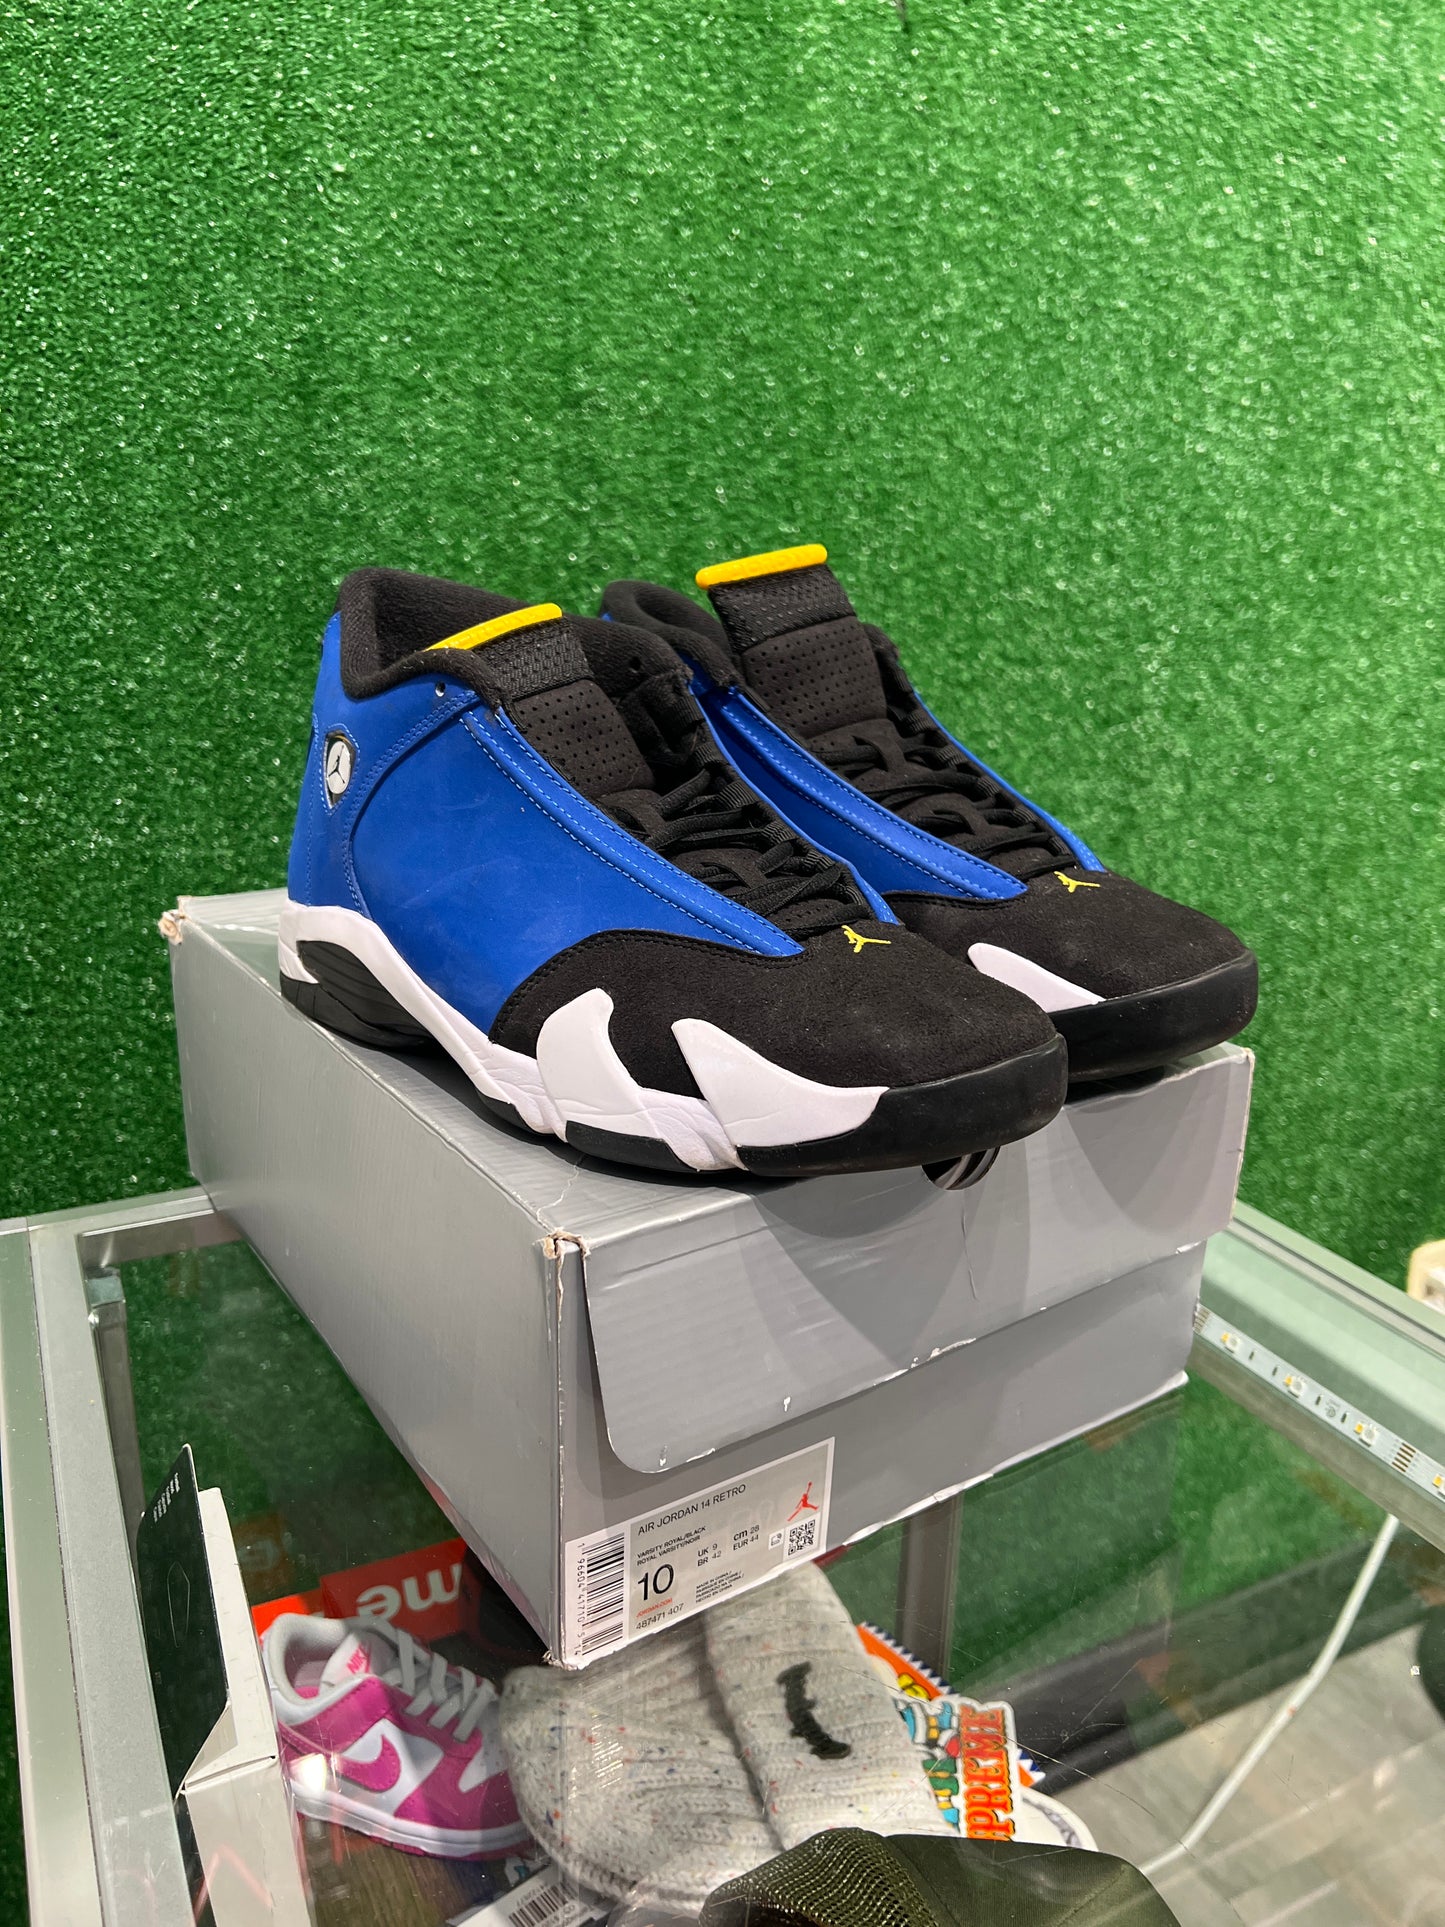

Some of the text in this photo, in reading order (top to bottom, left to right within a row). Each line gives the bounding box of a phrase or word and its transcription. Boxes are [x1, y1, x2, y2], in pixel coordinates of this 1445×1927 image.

[638, 1484, 746, 1536] AIR JORDAN 14 RETRO
[636, 1526, 706, 1559] VARSITY ROYAL/BLACK
[733, 1534, 759, 1551] EUR 44
[734, 1525, 760, 1541] cm 28
[636, 1535, 700, 1566] ROYAL VARSITY/NOIR
[698, 1547, 709, 1557] UK
[698, 1550, 722, 1567] BR 42
[576, 1558, 586, 1588] 96604
[638, 1564, 674, 1601] 10
[577, 1595, 585, 1623] 41710
[636, 1603, 684, 1630] 487471 407
[347, 1643, 370, 1674] NIK
[960, 1704, 1016, 1841] PREME
